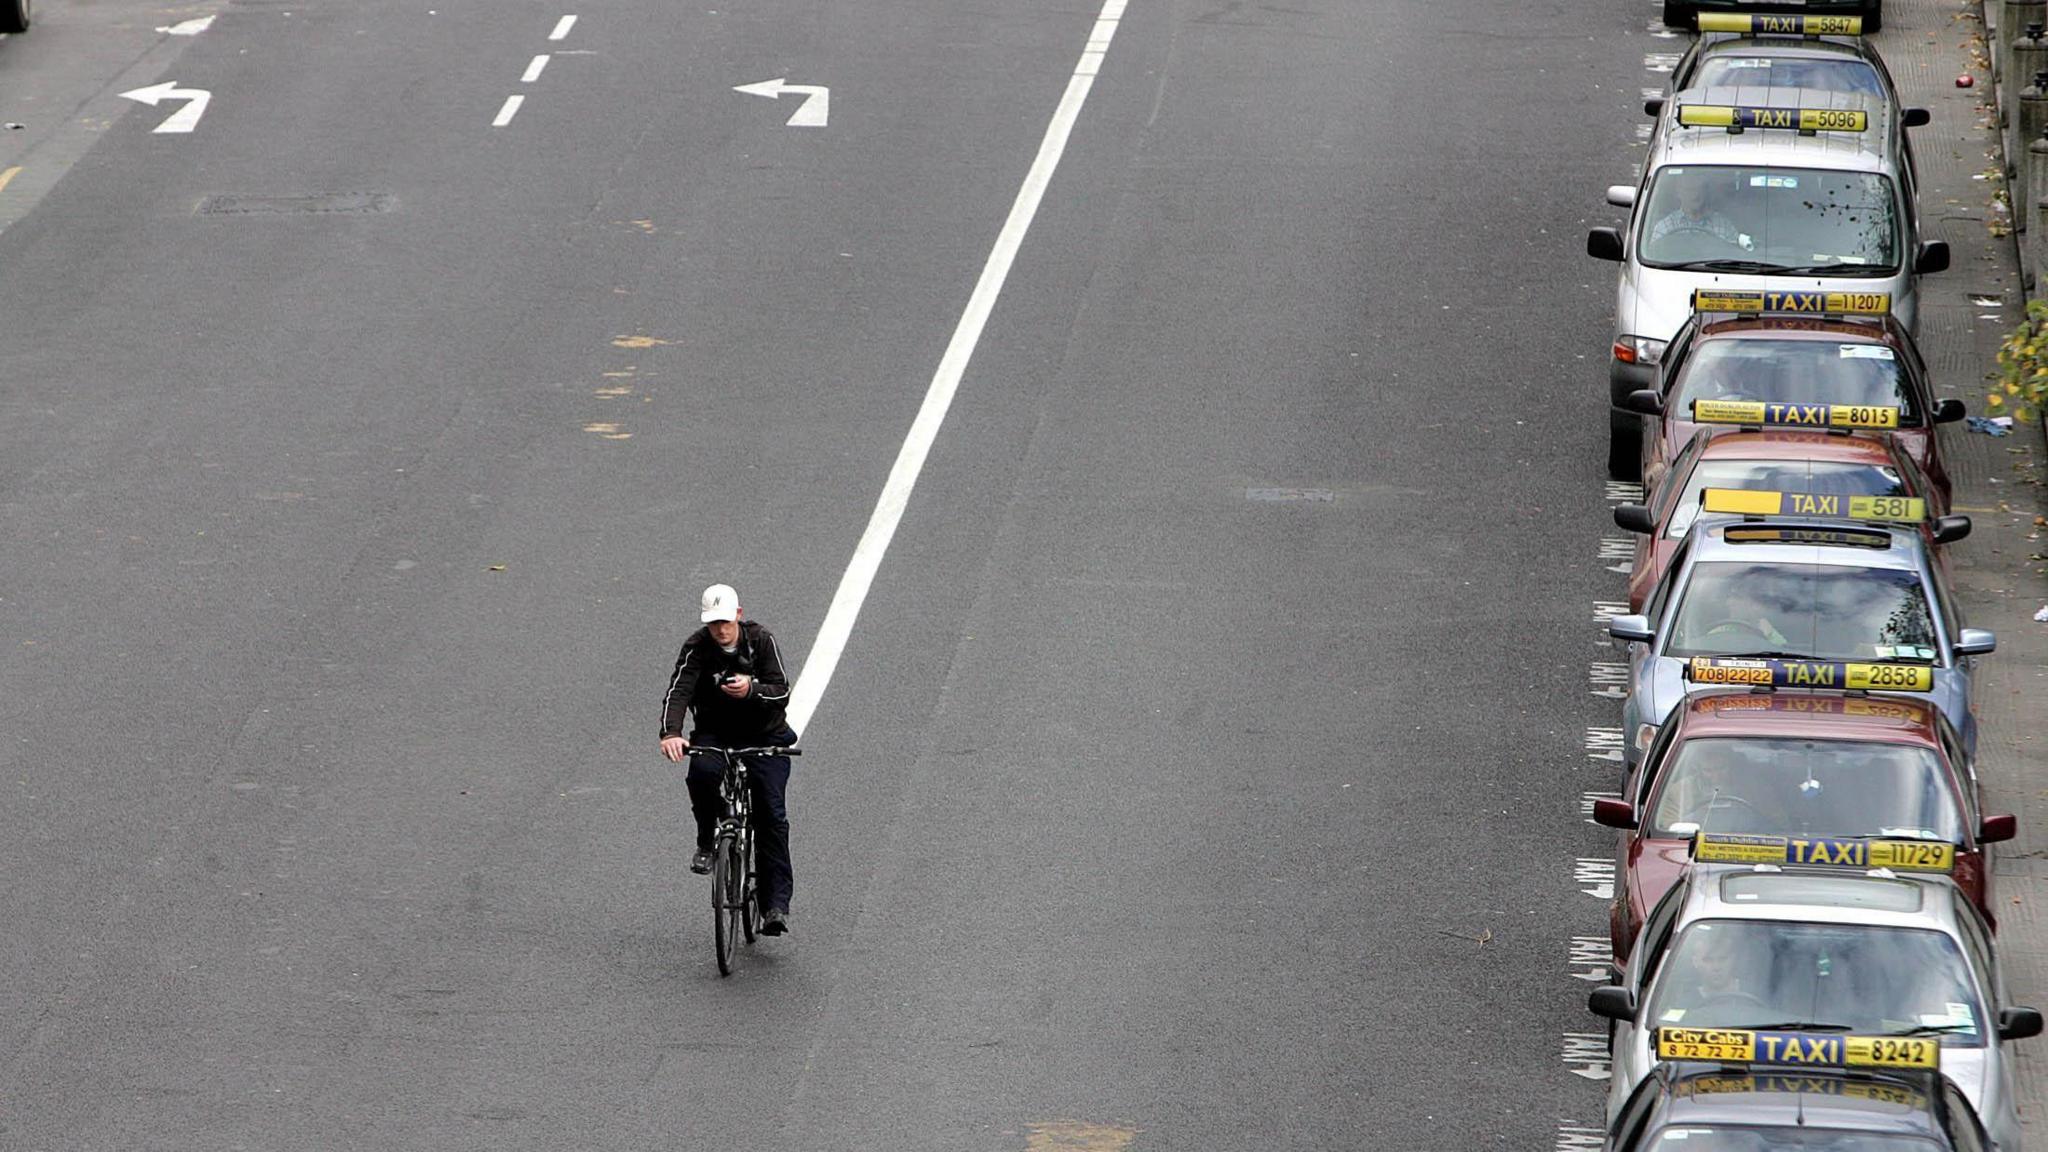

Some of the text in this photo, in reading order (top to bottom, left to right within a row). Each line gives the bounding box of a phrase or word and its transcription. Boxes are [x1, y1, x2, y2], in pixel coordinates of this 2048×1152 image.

[1761, 16, 1796, 32] TAXI
[1820, 18, 1852, 32] 5847
[1752, 109, 1791, 128] TAXI
[1818, 112, 1856, 128] 5096
[1768, 294, 1823, 311] TAXI
[1842, 294, 1882, 311] 11207
[1770, 405, 1826, 424] TAXI
[1850, 408, 1889, 424] 8015
[1792, 494, 1838, 514] TAXI
[1873, 498, 1910, 517] 581
[1697, 668, 1771, 682] 708 22 22
[1784, 663, 1834, 685] TAXI
[1870, 666, 1918, 686] 2858
[1792, 840, 1864, 865] TAXI
[1890, 843, 1944, 865] 11729
[1670, 1030, 1744, 1046] City Cabs
[1668, 1045, 1746, 1059] 8 72 72 72
[1763, 1036, 1838, 1063] TAXI
[1872, 1040, 1925, 1063] 8242
